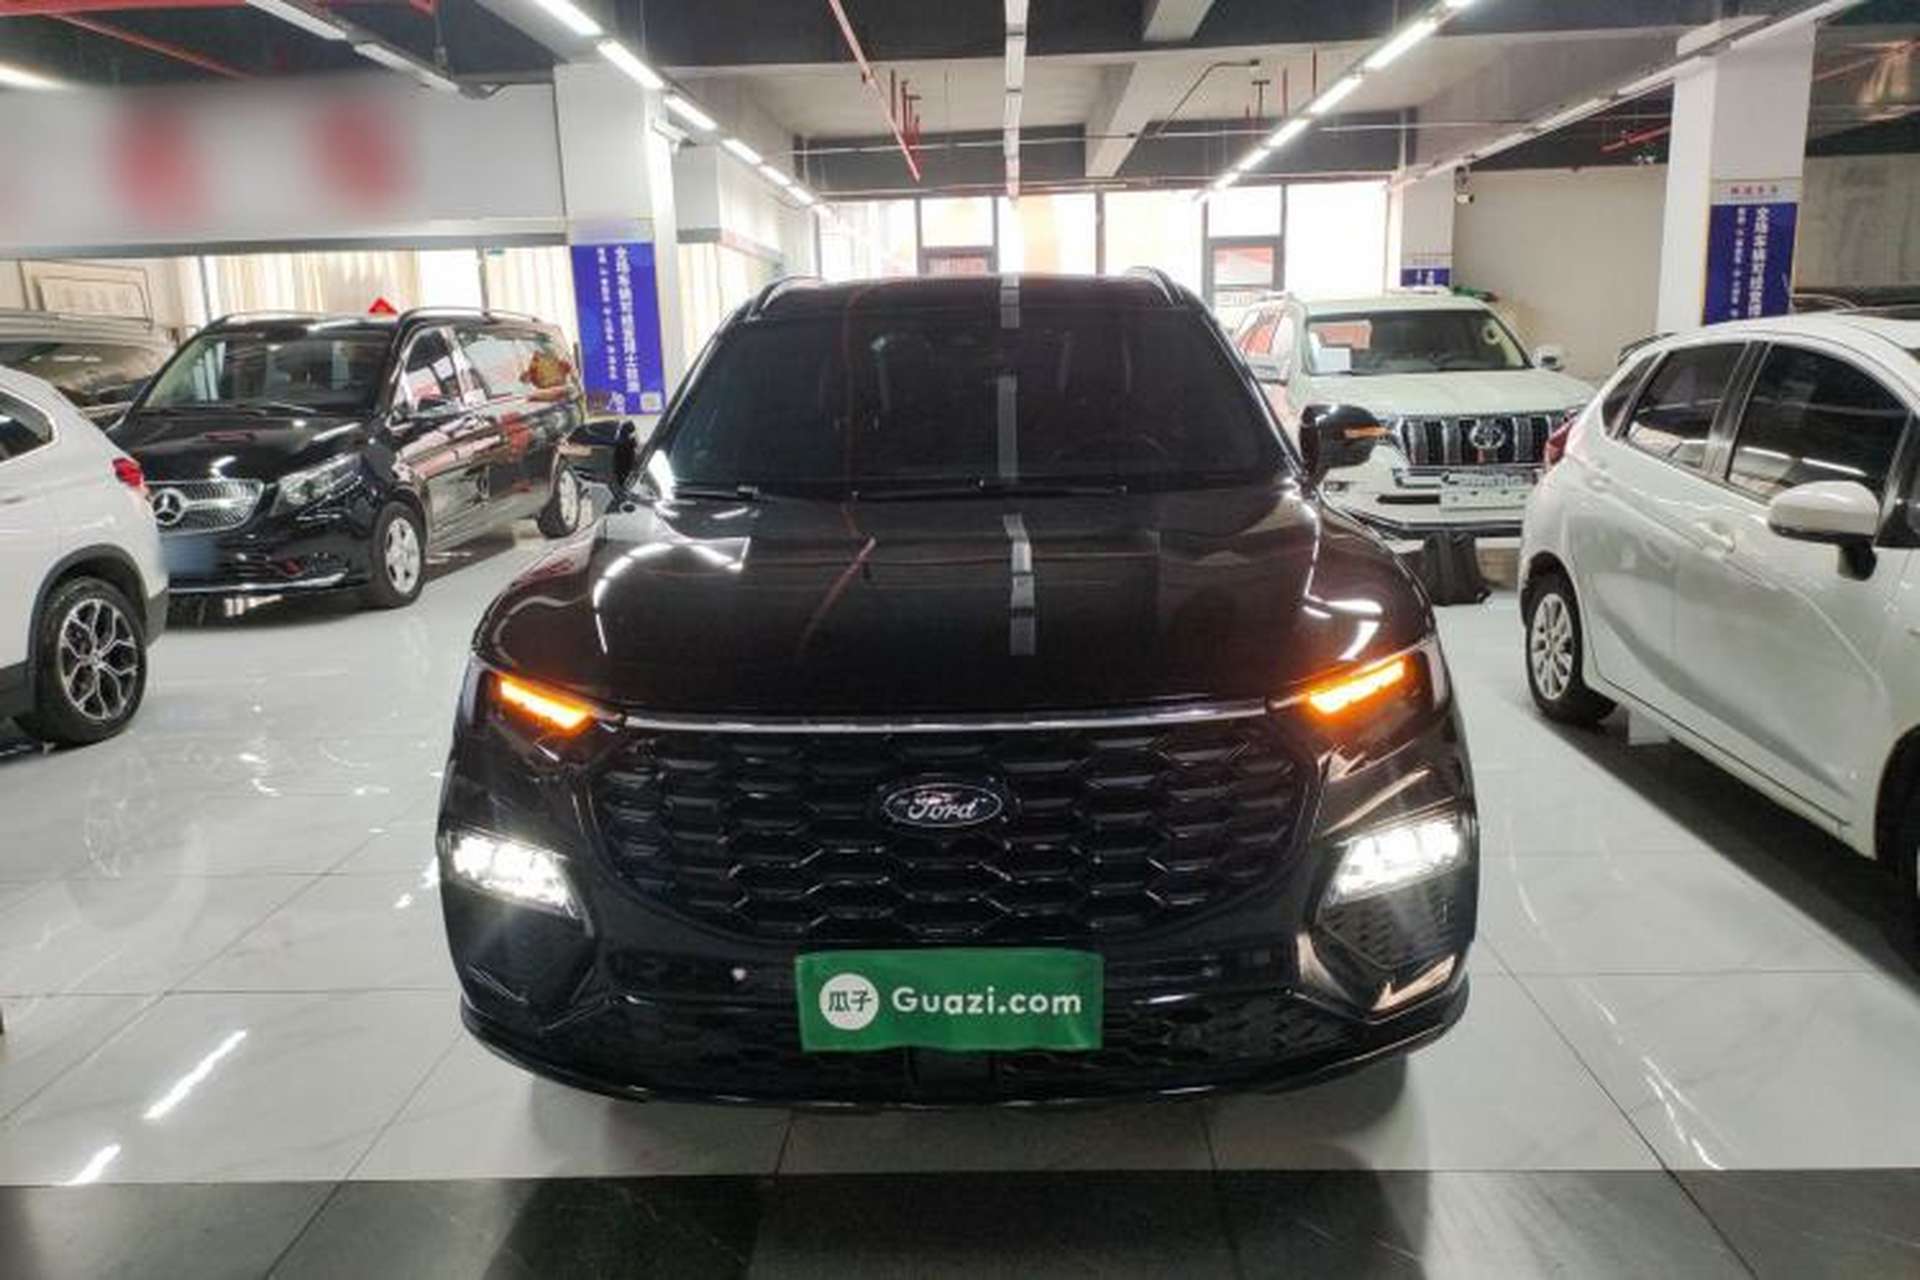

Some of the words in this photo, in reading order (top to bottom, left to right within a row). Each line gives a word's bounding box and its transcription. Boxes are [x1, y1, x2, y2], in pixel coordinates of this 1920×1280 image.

[907, 790, 977, 820] Ford
[827, 989, 872, 1013] 瓜子
[891, 985, 1082, 1015] Guazi.com
